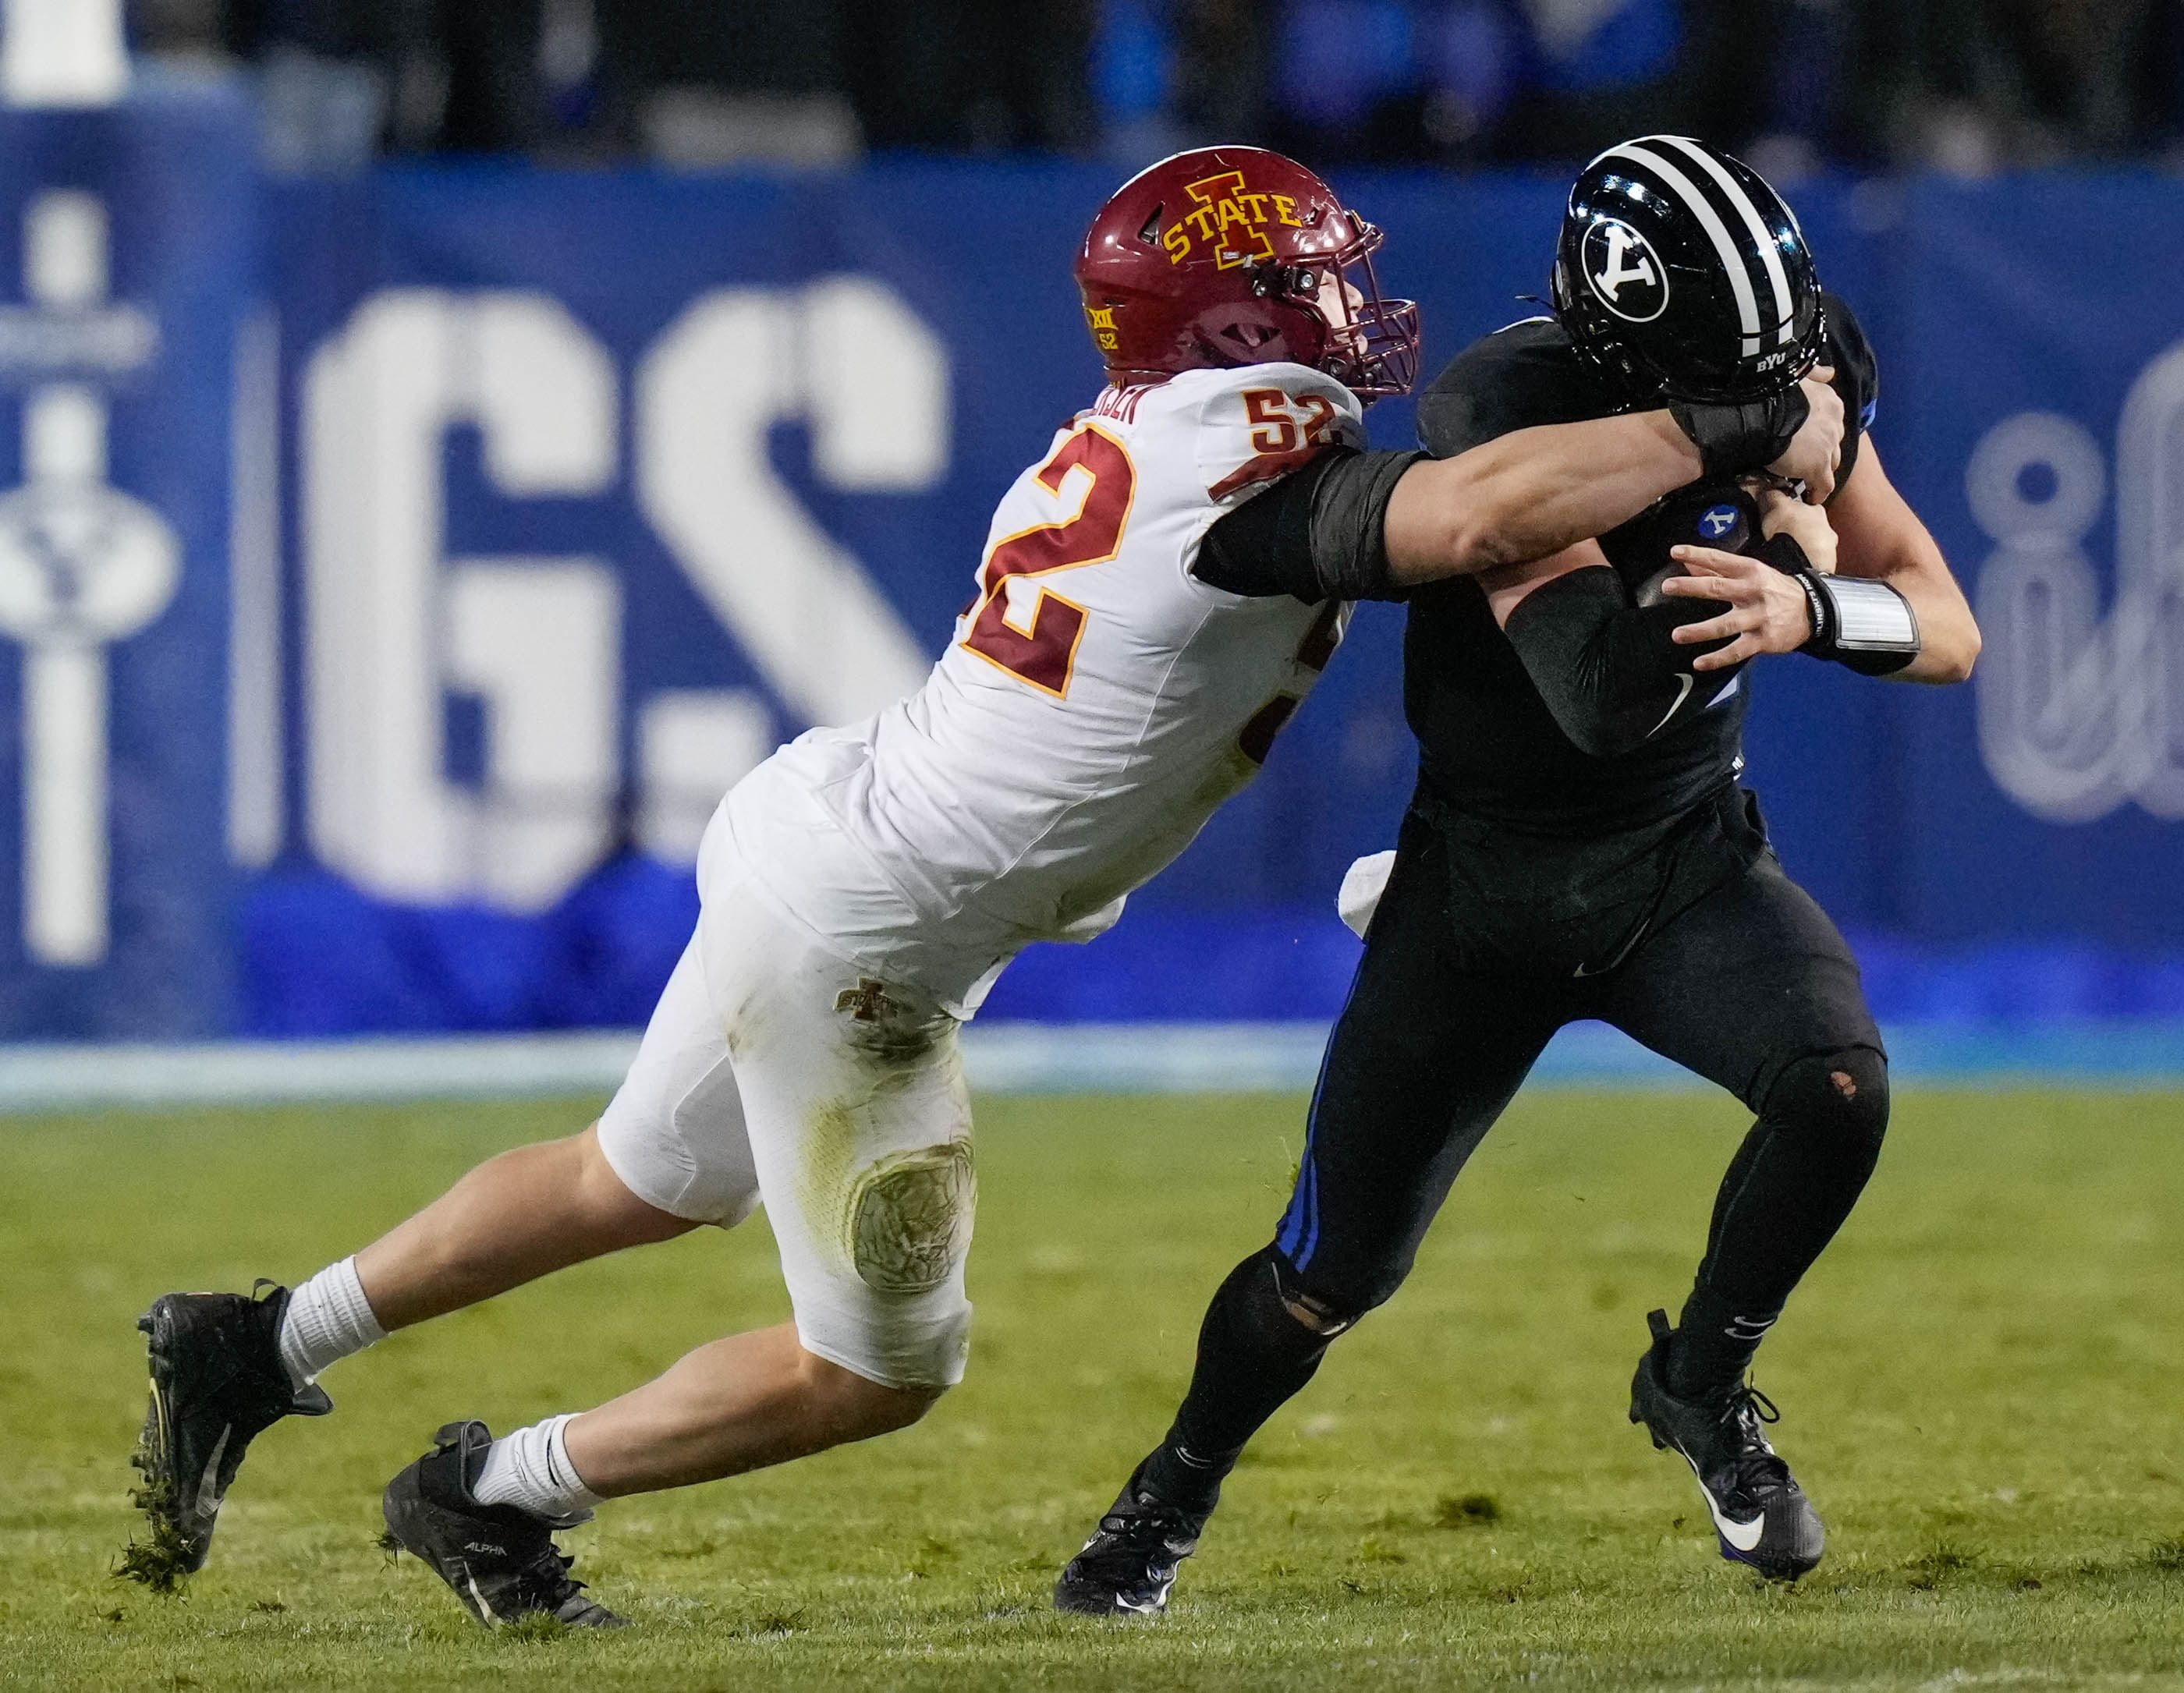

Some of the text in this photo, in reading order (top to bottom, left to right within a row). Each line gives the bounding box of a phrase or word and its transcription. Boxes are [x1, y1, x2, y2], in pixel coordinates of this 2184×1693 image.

[1161, 193, 1303, 265] STATE
[1098, 333, 1119, 349] 52
[1756, 352, 1786, 373] BYU
[1242, 387, 1344, 455] 52
[959, 422, 1136, 701] 2
[464, 1542, 508, 1556] ALPHA
